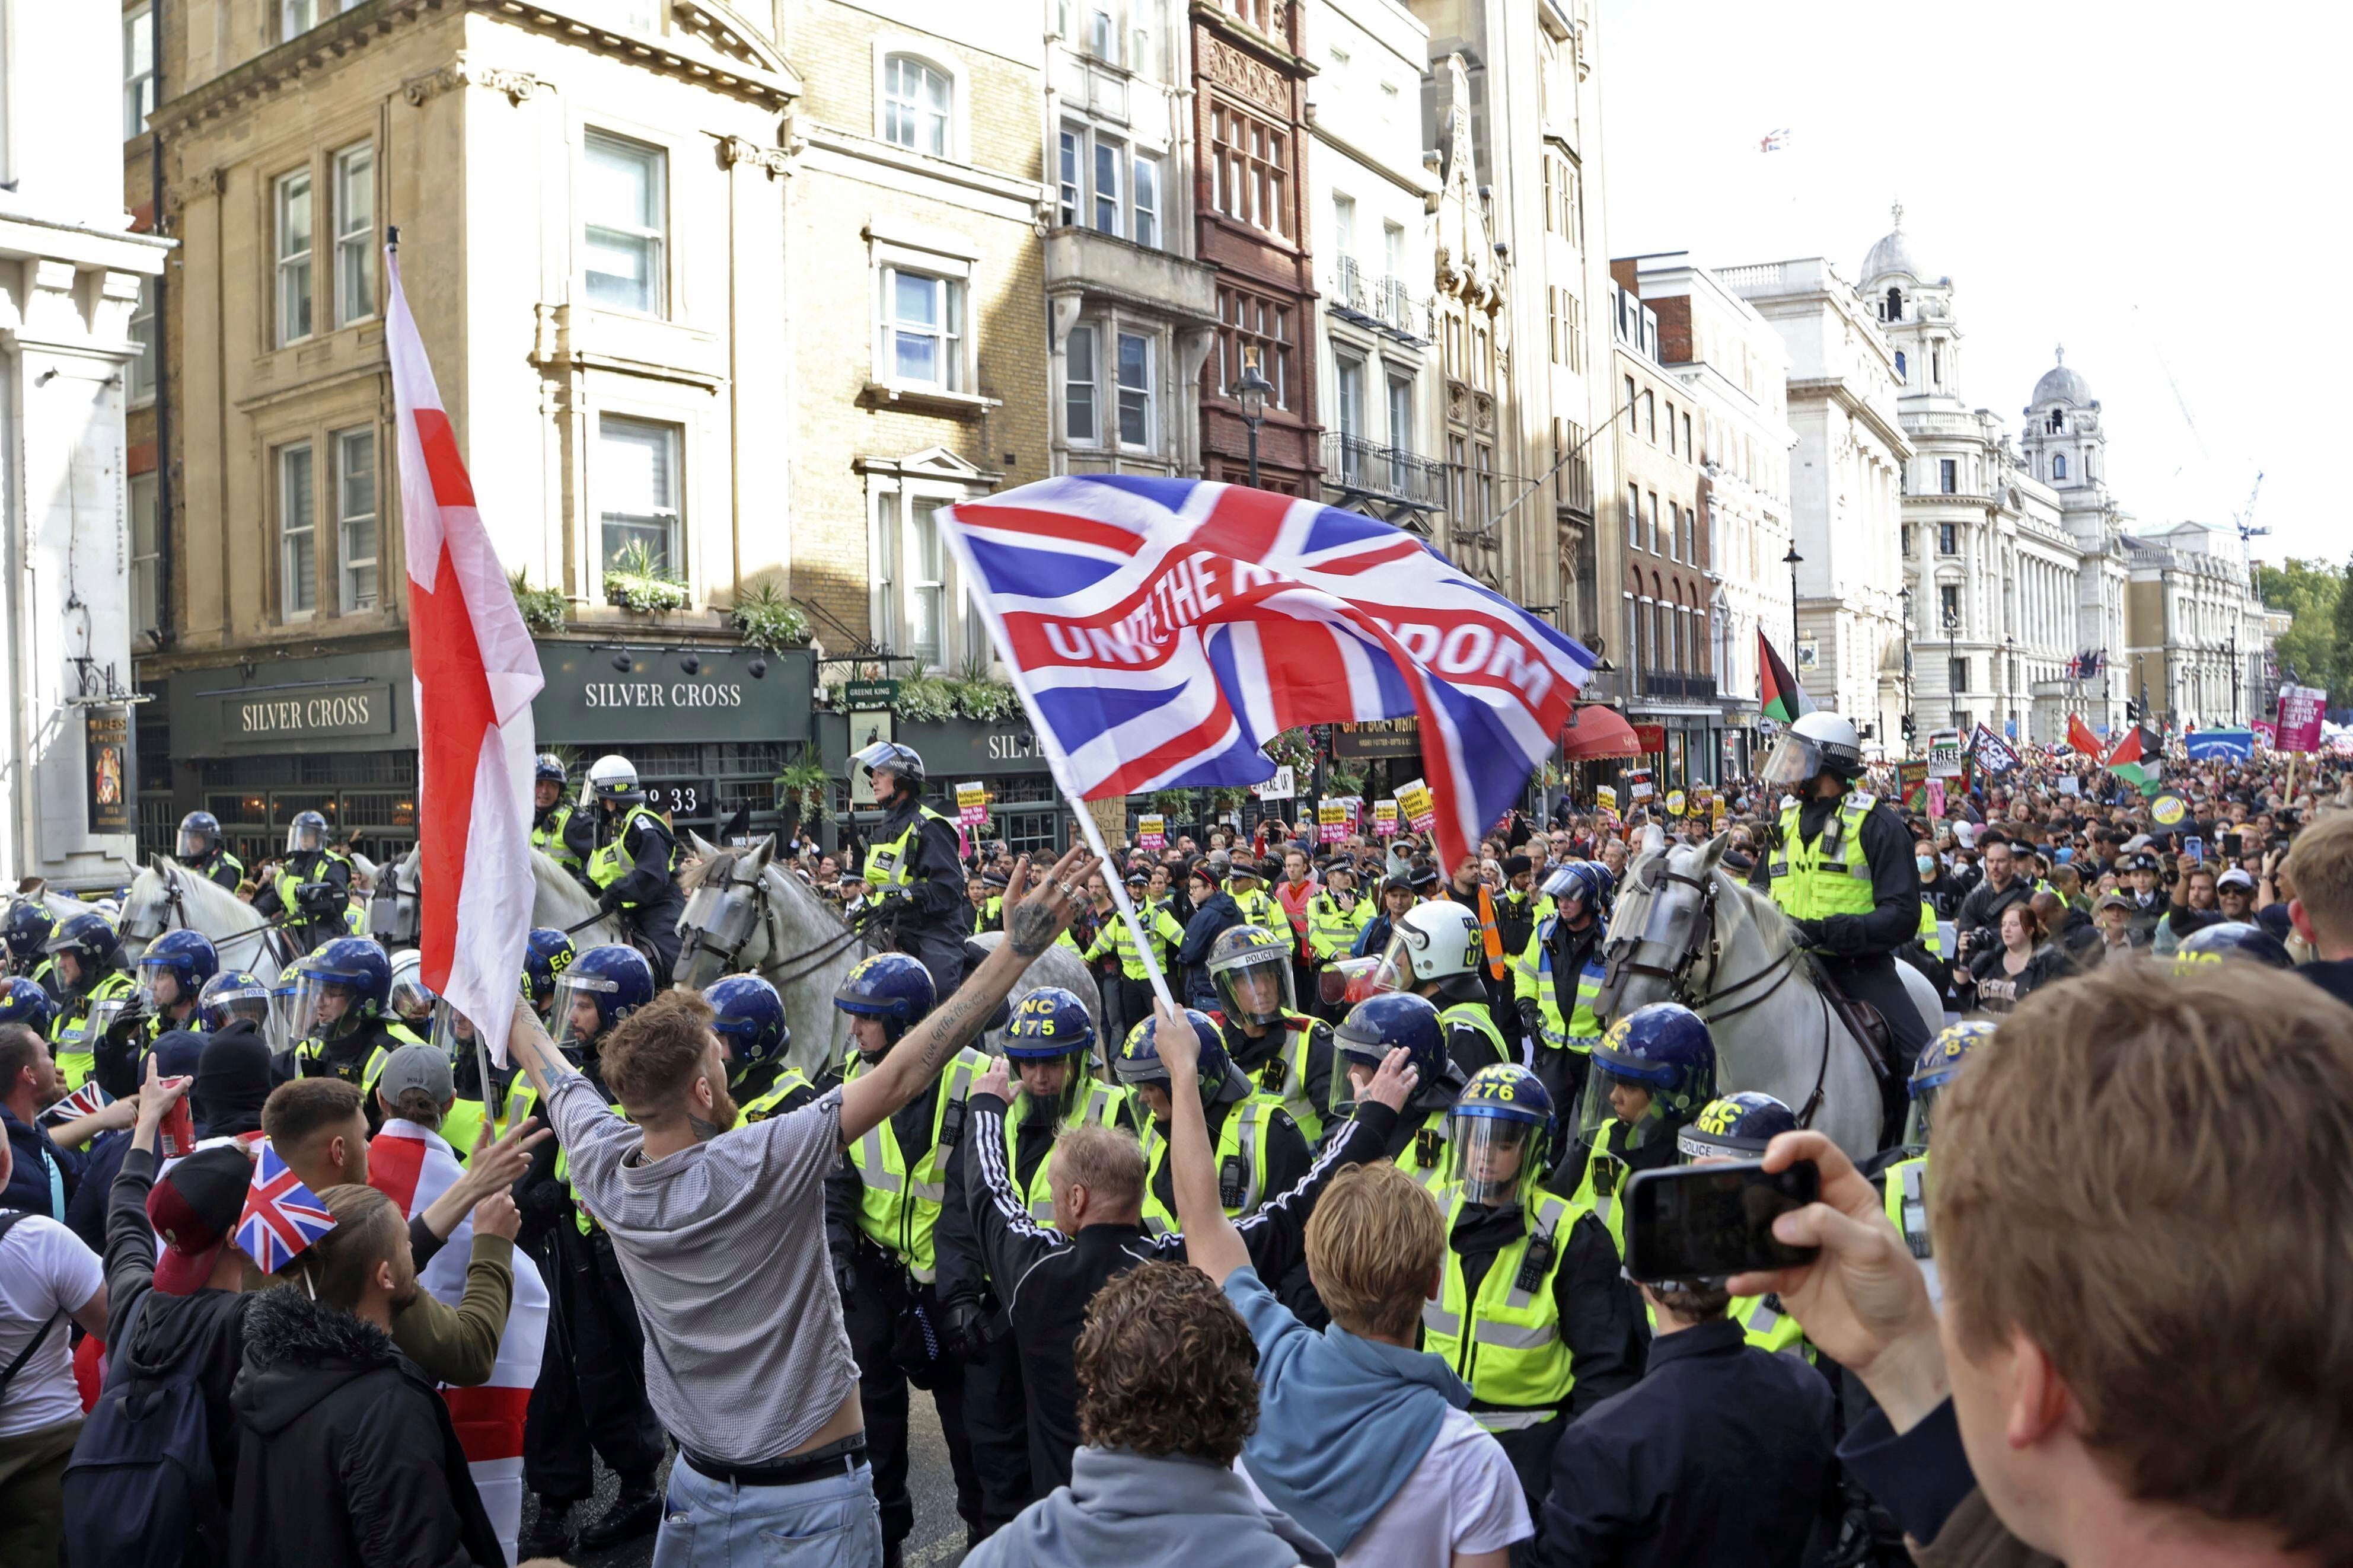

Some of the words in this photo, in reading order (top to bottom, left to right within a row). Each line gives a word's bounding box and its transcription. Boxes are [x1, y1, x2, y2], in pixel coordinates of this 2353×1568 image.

[1155, 551, 1223, 630] THE
[585, 683, 665, 707] SILVER
[672, 683, 741, 707] CROSS
[243, 702, 302, 732] SILVER
[308, 696, 368, 727] CROSS
[1343, 720, 1363, 733] GIFT
[1394, 716, 1417, 732] WHIT
[989, 735, 1046, 759] SILVE
[1929, 749, 1959, 761] FREE
[1930, 756, 1959, 768] PALESTINE
[671, 788, 697, 812] 33
[1400, 791, 1420, 803] Oppose
[1404, 799, 1423, 810] Tommy
[1096, 817, 1118, 829] NOT
[549, 950, 572, 971] EG
[1245, 951, 1274, 965] POLICE
[1020, 999, 1055, 1014] NC
[1010, 1020, 1055, 1036] 475
[1477, 1067, 1520, 1083] NC
[1466, 1082, 1514, 1101] 276
[1700, 1099, 1743, 1123] NC
[1683, 1139, 1713, 1156] POLICE
